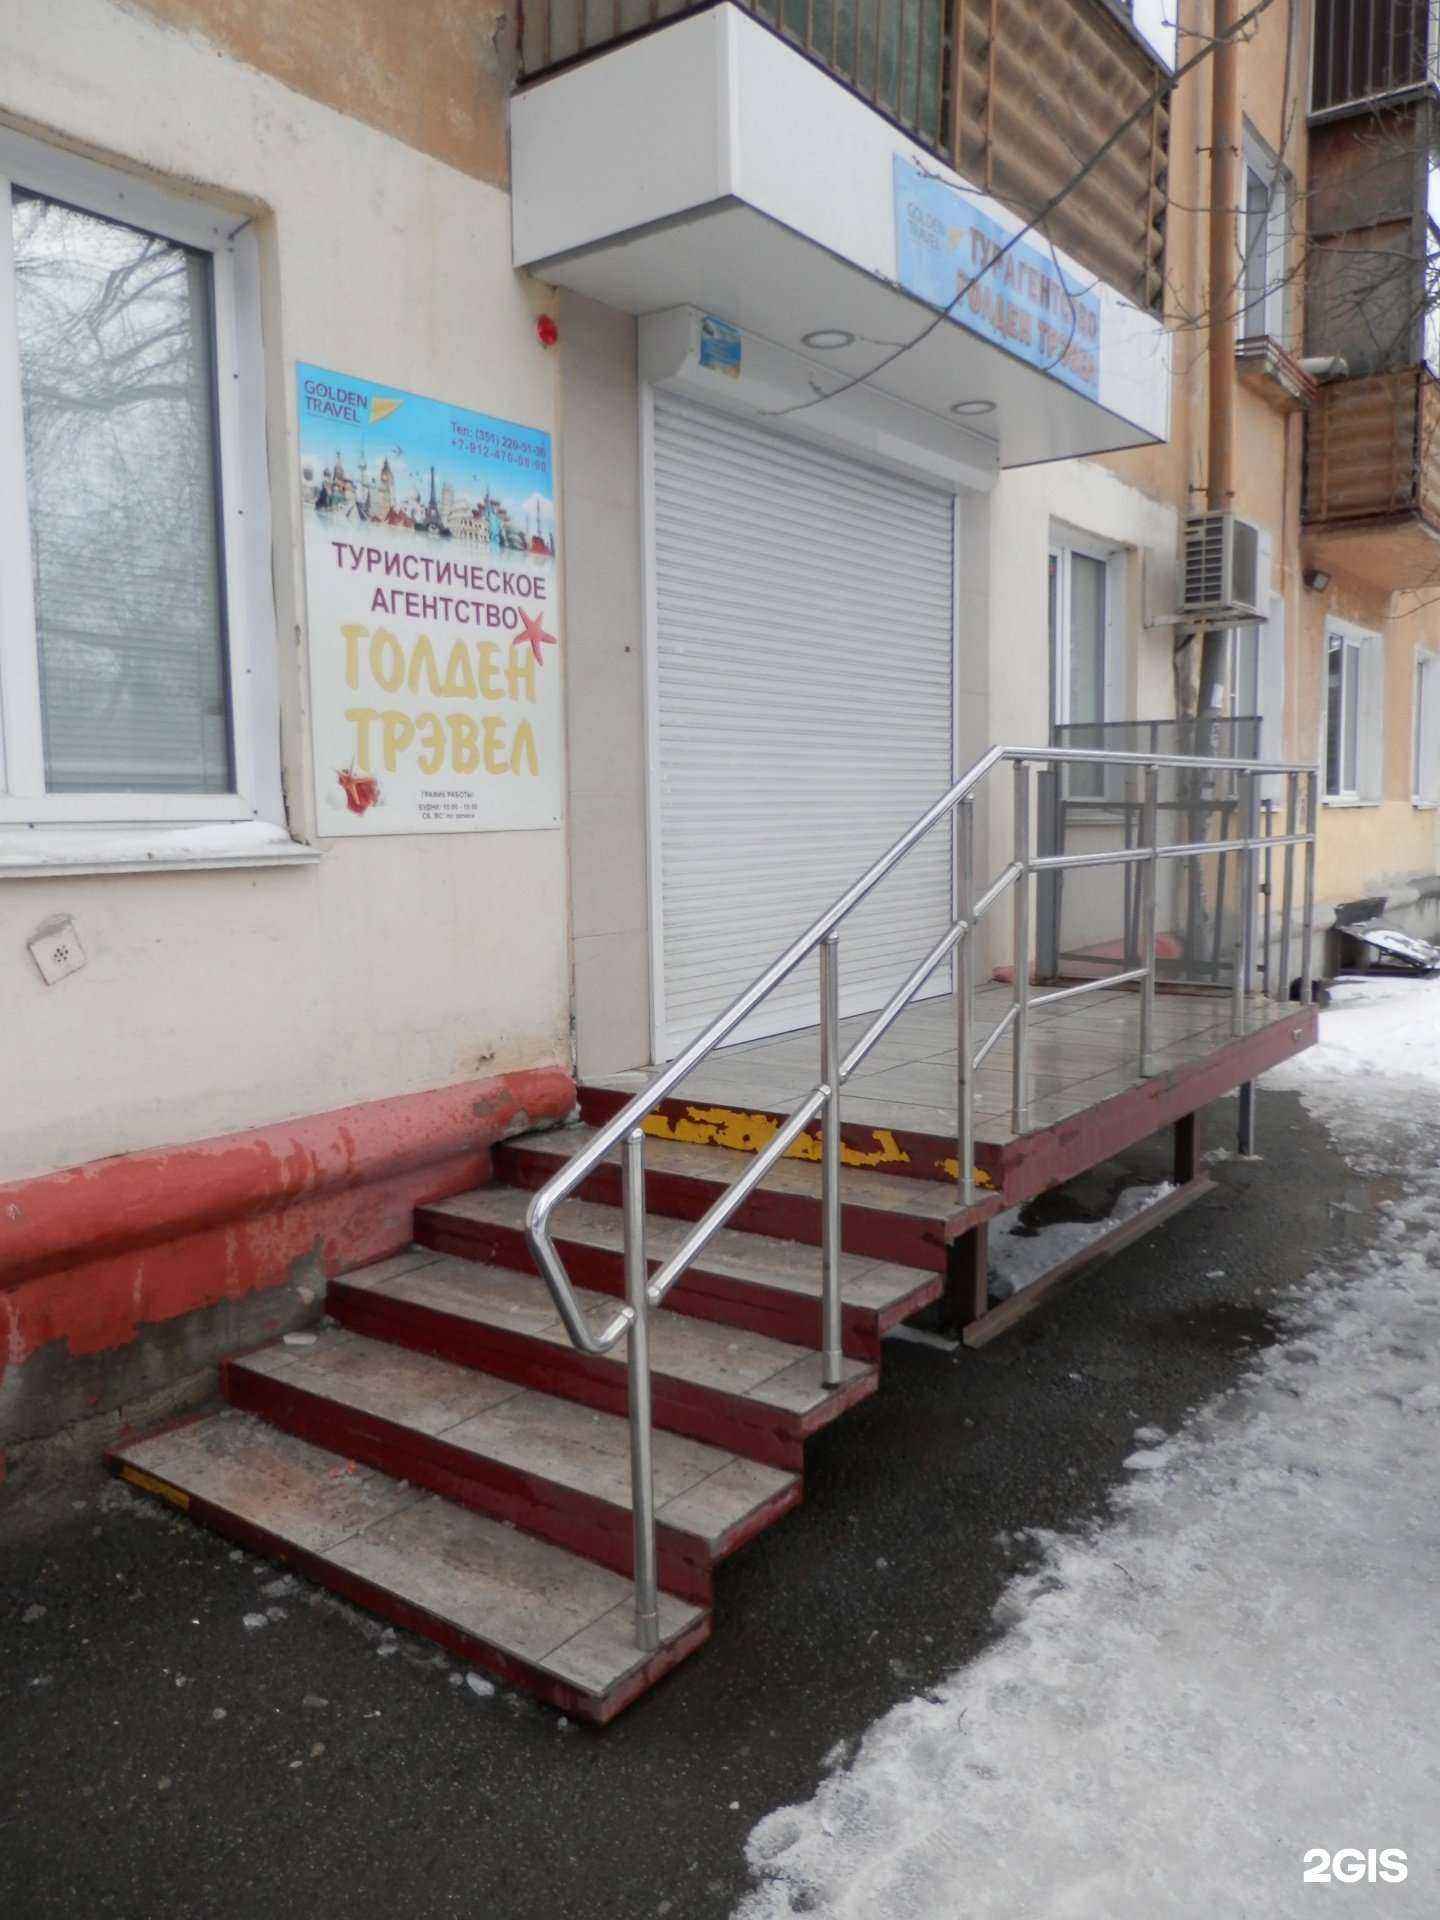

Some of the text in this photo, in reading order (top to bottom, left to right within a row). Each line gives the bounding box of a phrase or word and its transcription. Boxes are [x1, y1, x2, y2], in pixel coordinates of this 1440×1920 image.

[304, 379, 368, 410] GOLDEN
[305, 396, 361, 424] TRAVEL
[331, 541, 547, 600] ТУРИСТИЧЕСКОЕ
[371, 586, 519, 630] АГЕНТСТВО
[345, 707, 540, 777] ТРЭВЕЛ
